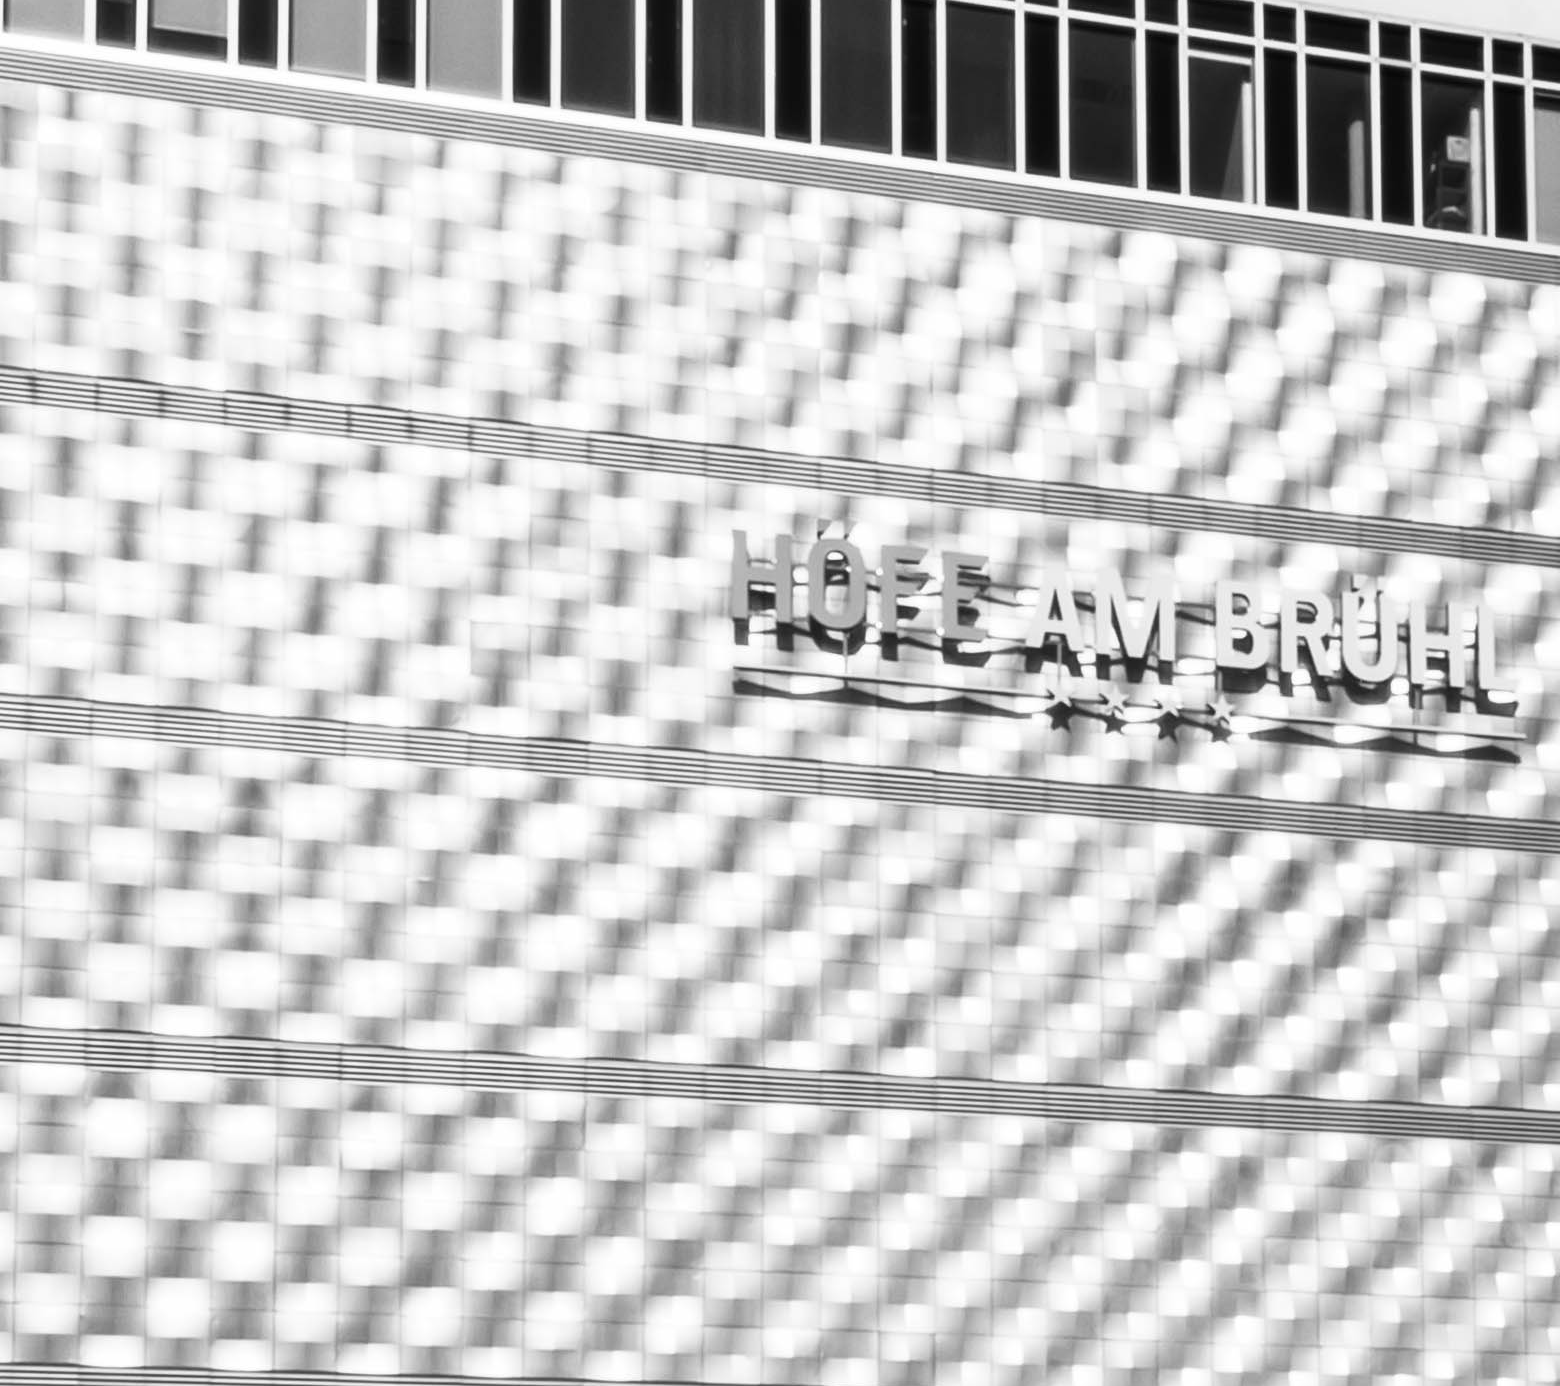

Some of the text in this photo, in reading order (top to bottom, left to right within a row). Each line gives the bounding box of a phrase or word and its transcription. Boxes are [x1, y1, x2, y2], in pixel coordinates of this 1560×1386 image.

[731, 518, 1519, 692] HÖFE AM BRÜHL
